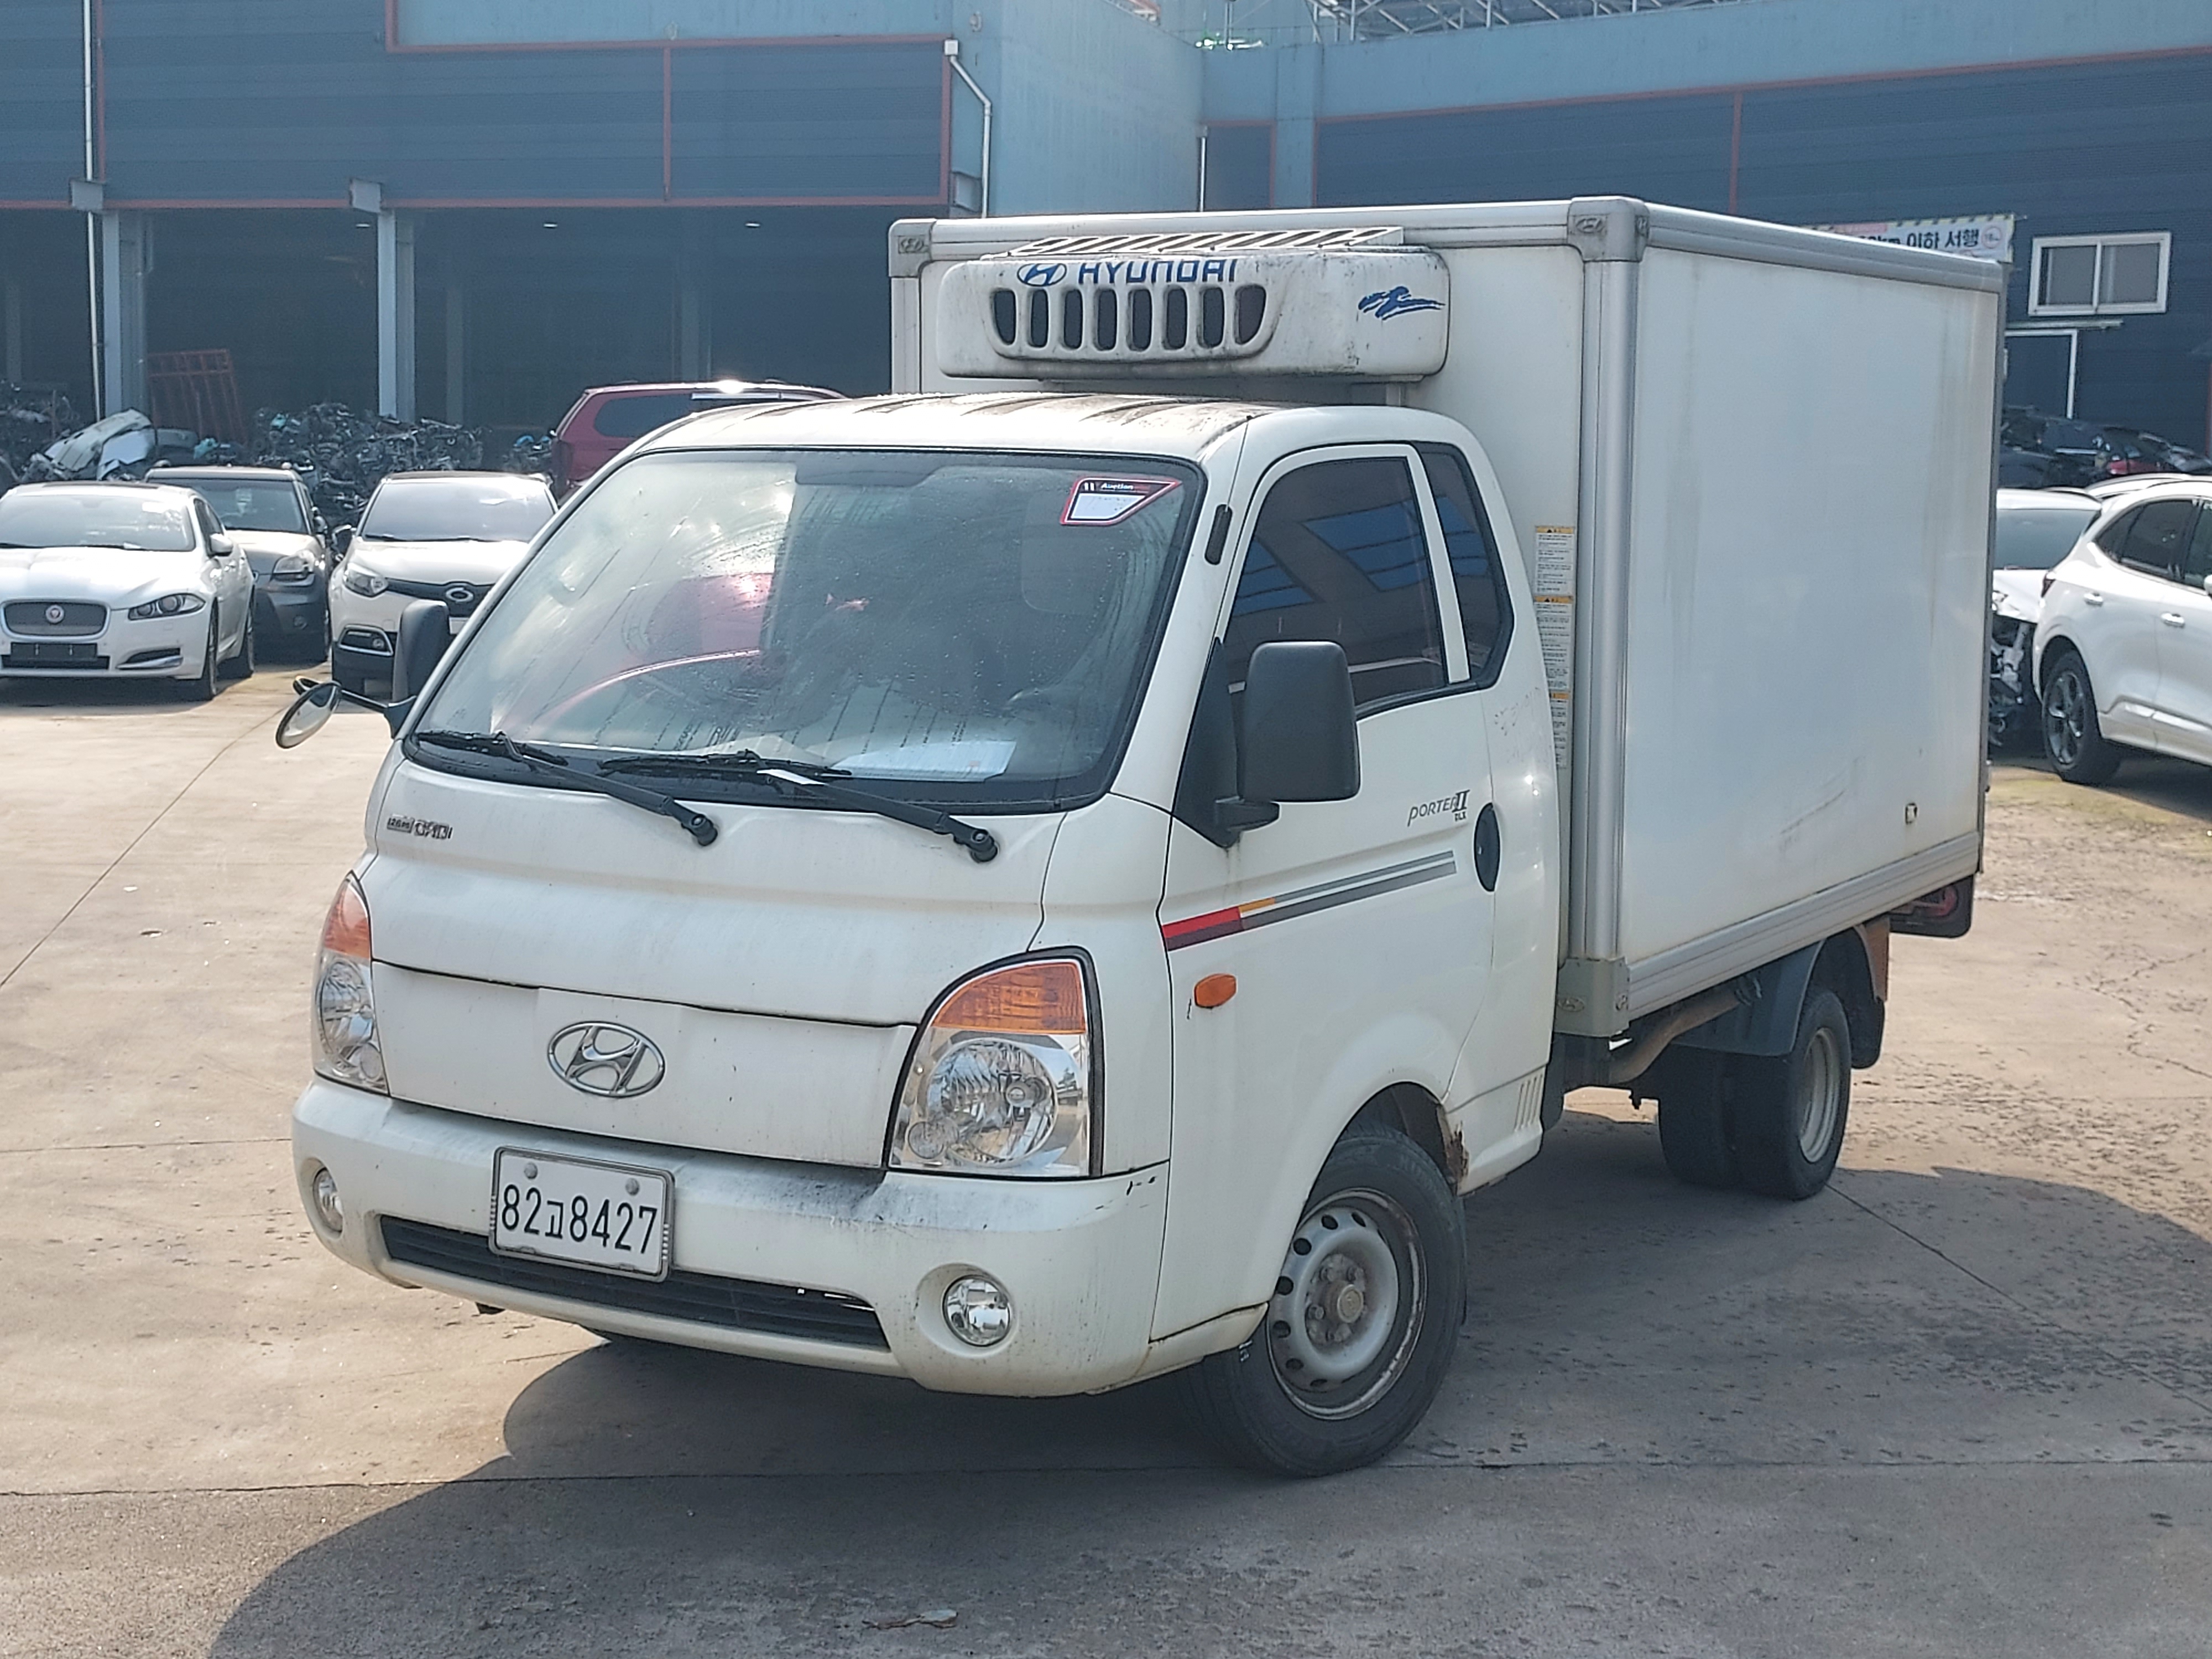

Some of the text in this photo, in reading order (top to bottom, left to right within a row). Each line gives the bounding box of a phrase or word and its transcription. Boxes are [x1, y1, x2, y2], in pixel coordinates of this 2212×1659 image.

[1945, 229, 1979, 248] 서행
[1078, 259, 1236, 284] HYUNDAI
[1100, 482, 1134, 491] Auction
[501, 1183, 658, 1254] 82고8427
